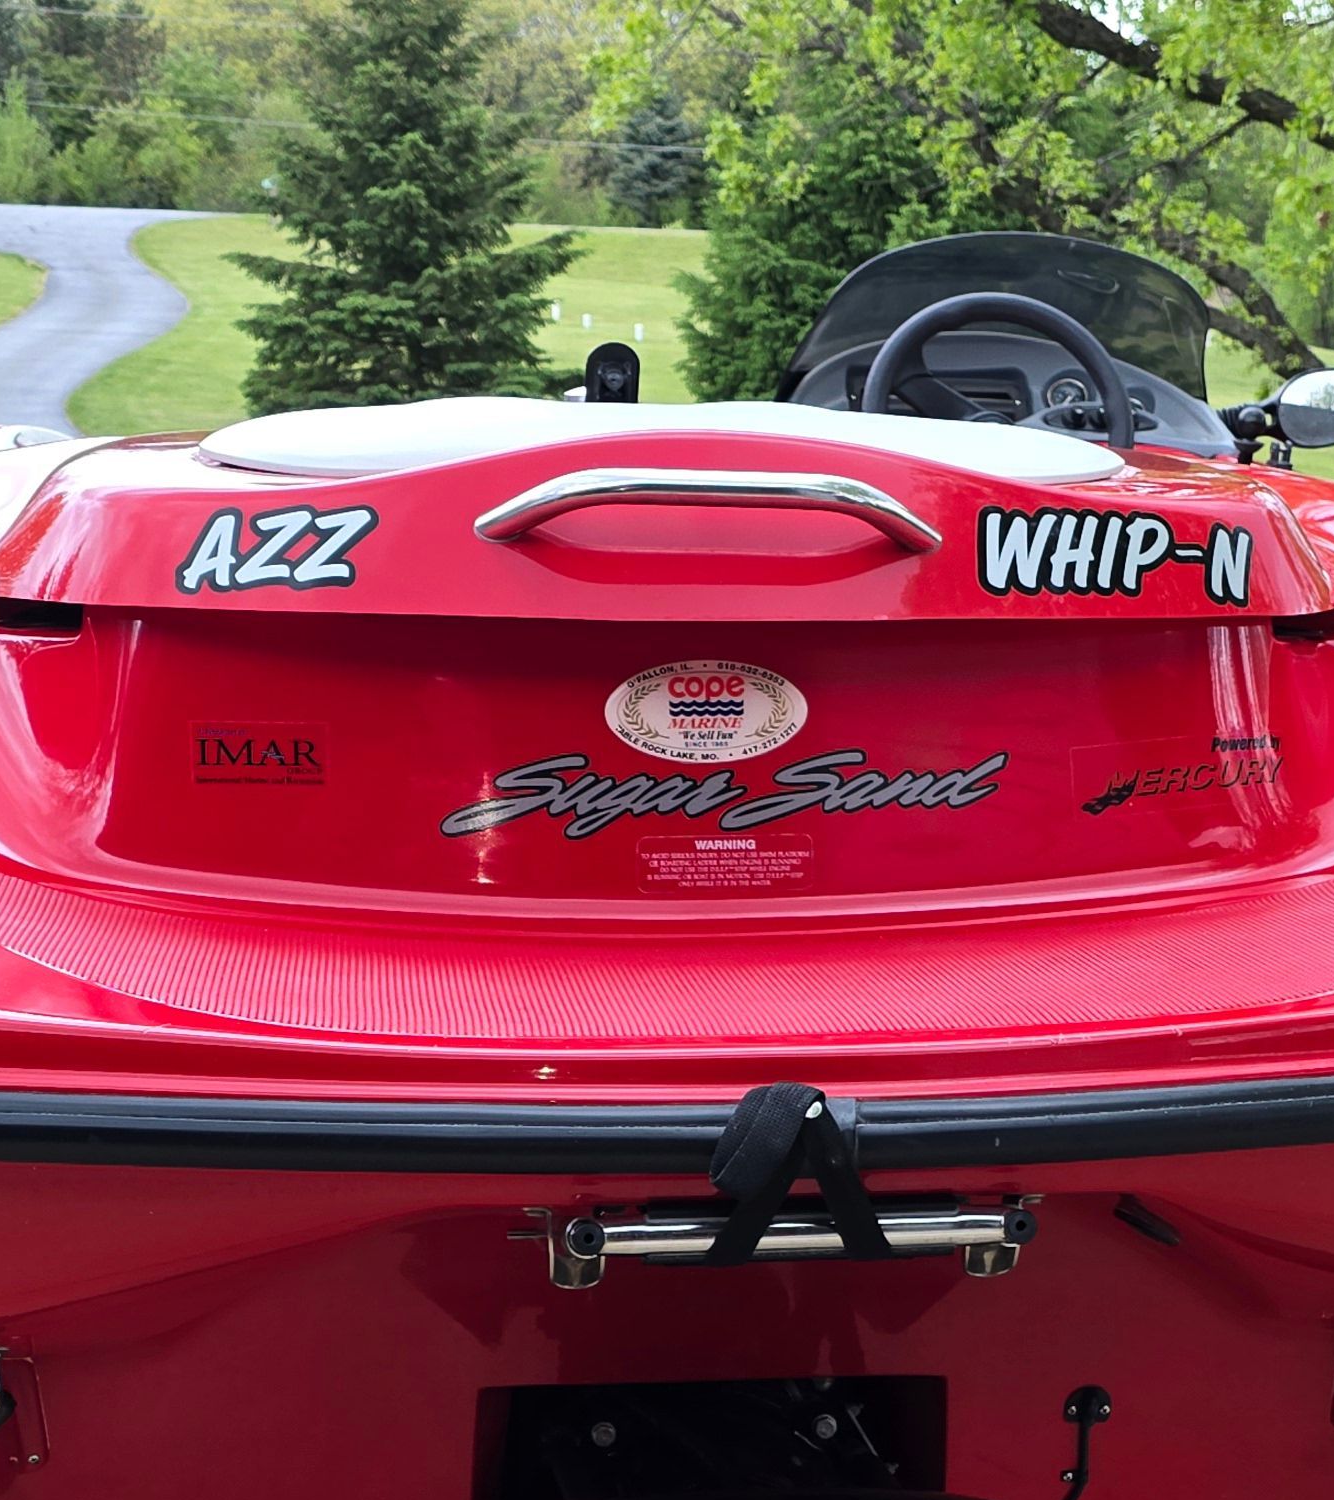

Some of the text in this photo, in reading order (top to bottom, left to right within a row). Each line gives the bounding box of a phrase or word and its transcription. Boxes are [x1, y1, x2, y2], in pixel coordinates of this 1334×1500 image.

[176, 505, 1253, 607] AZZ WHIP-N
[668, 675, 745, 700] cope
[667, 717, 744, 729] MARINE
[696, 730, 714, 740] Sell
[194, 738, 322, 767] IMAR
[641, 740, 668, 755] ROCK
[440, 750, 1009, 839] Sugar Sand
[695, 839, 756, 850] WARNING
